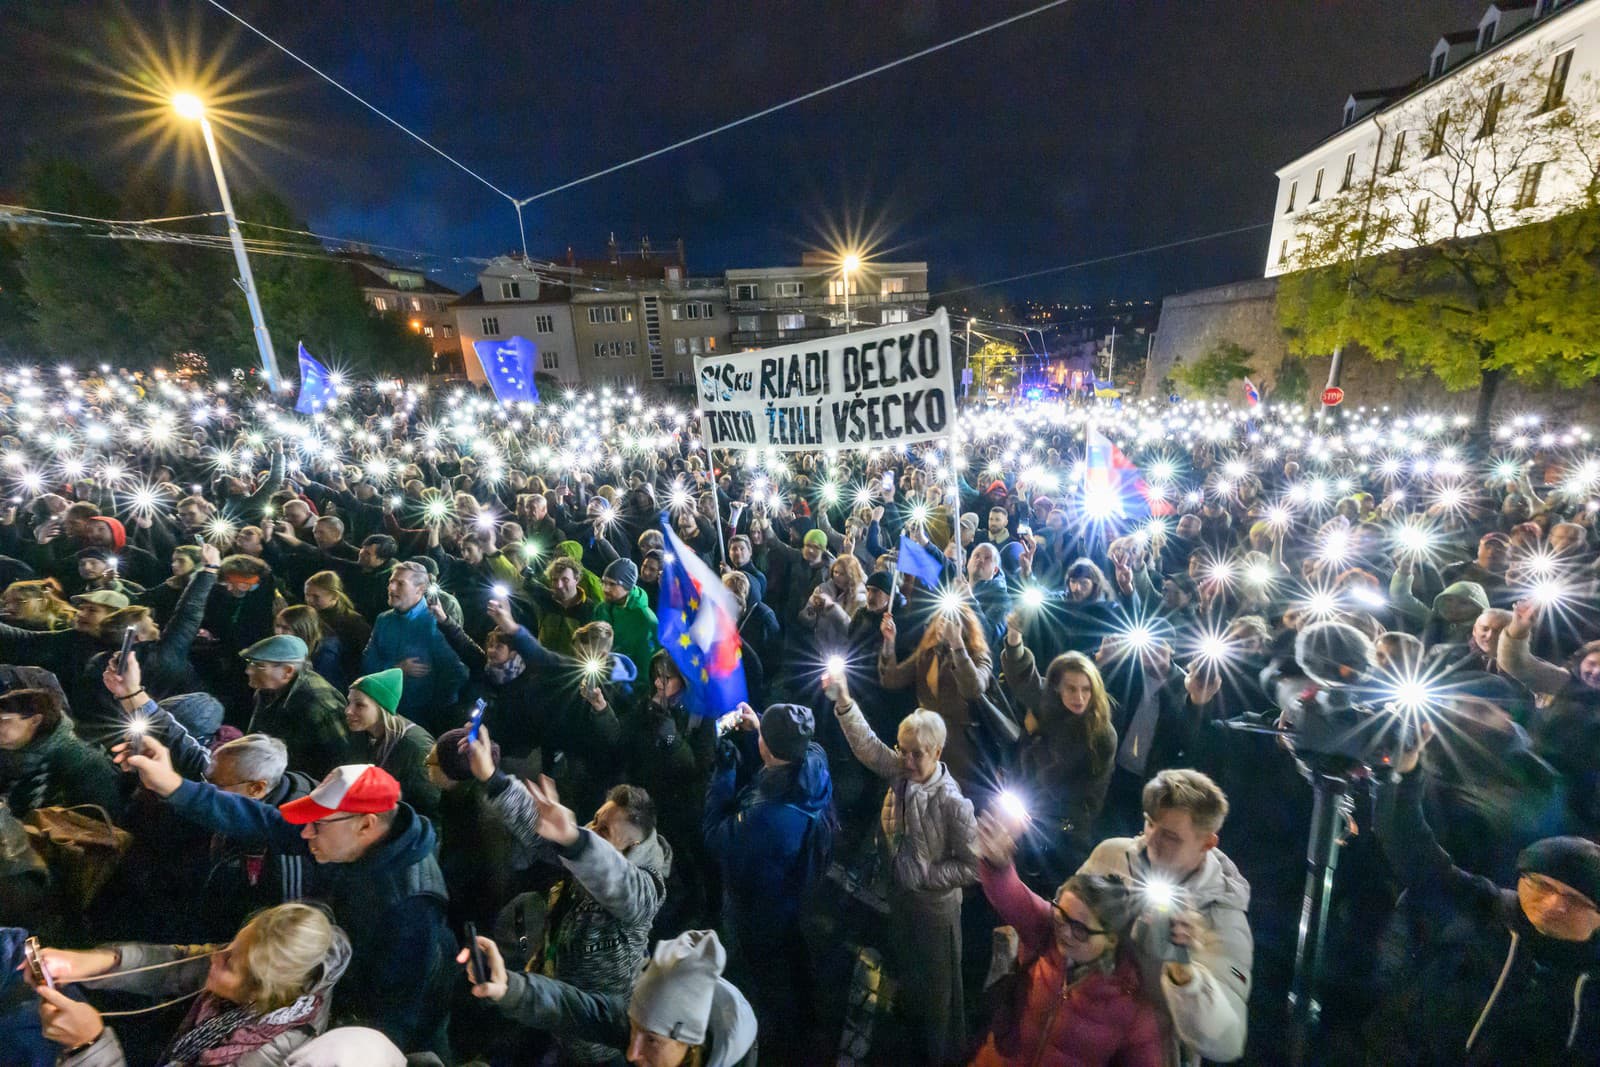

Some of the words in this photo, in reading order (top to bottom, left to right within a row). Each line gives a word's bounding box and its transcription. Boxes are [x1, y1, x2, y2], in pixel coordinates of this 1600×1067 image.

[760, 350, 830, 400] RIADI
[843, 329, 940, 392] DECKO
[764, 397, 823, 445] ŽEHLÍ
[832, 388, 946, 443] VŠECKO
